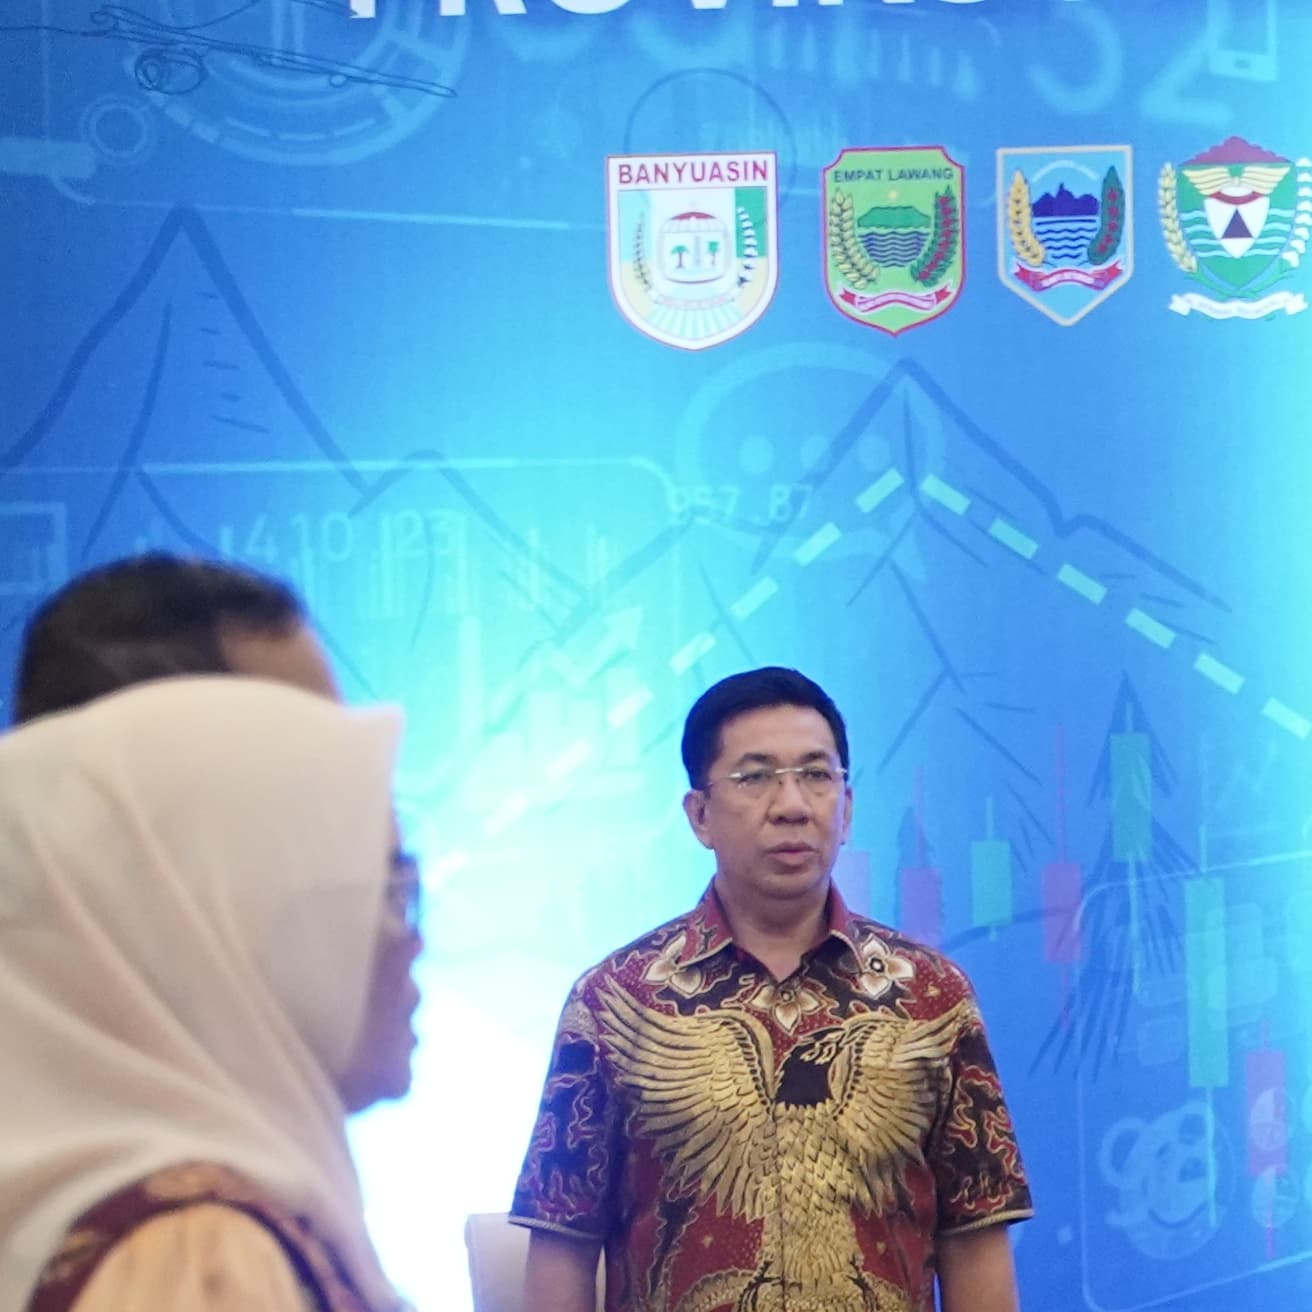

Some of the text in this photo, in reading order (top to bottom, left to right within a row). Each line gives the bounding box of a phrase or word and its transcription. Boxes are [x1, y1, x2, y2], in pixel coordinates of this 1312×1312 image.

[617, 159, 769, 184] BANYUASIN
[833, 167, 954, 183] EMPAT LAWANG
